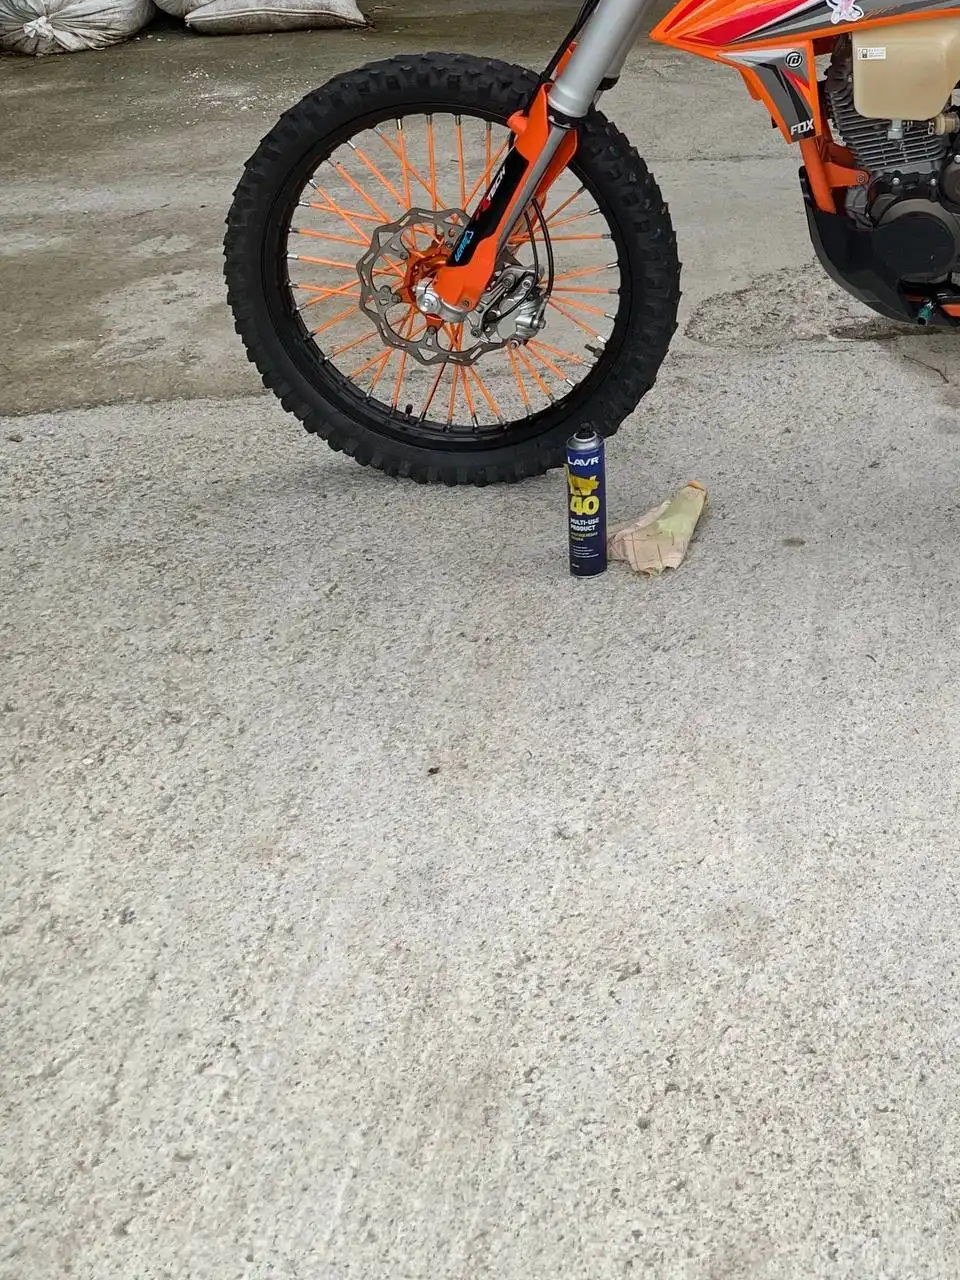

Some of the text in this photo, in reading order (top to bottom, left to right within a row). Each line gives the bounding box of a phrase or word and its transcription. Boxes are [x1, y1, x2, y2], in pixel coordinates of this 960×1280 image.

[791, 118, 814, 136] FOX
[568, 456, 600, 466] LAVR
[570, 495, 600, 516] 40
[570, 517, 600, 526] MULTI-USE
[570, 524, 596, 532] PRODUCT
